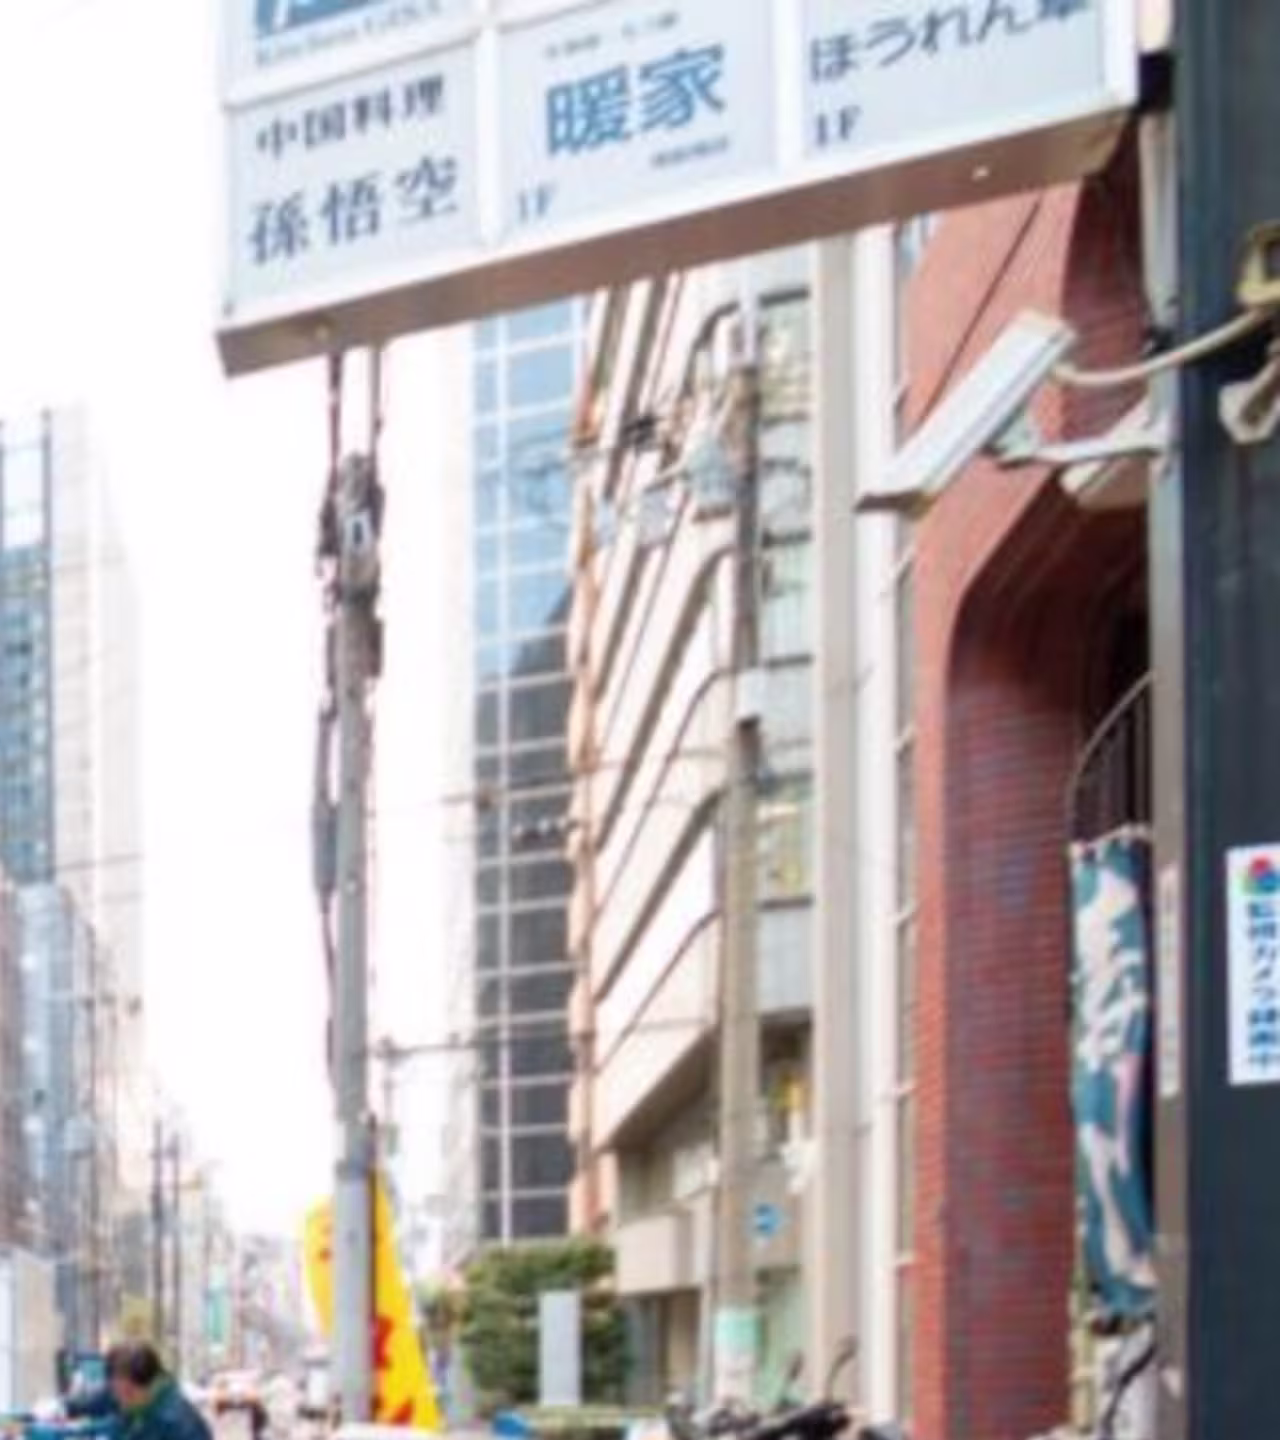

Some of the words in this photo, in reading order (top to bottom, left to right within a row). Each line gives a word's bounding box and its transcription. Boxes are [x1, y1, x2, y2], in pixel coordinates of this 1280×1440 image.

[255, 77, 444, 157] 中国料理
[547, 46, 725, 155] 暖家
[247, 155, 458, 265] 孫悟空
